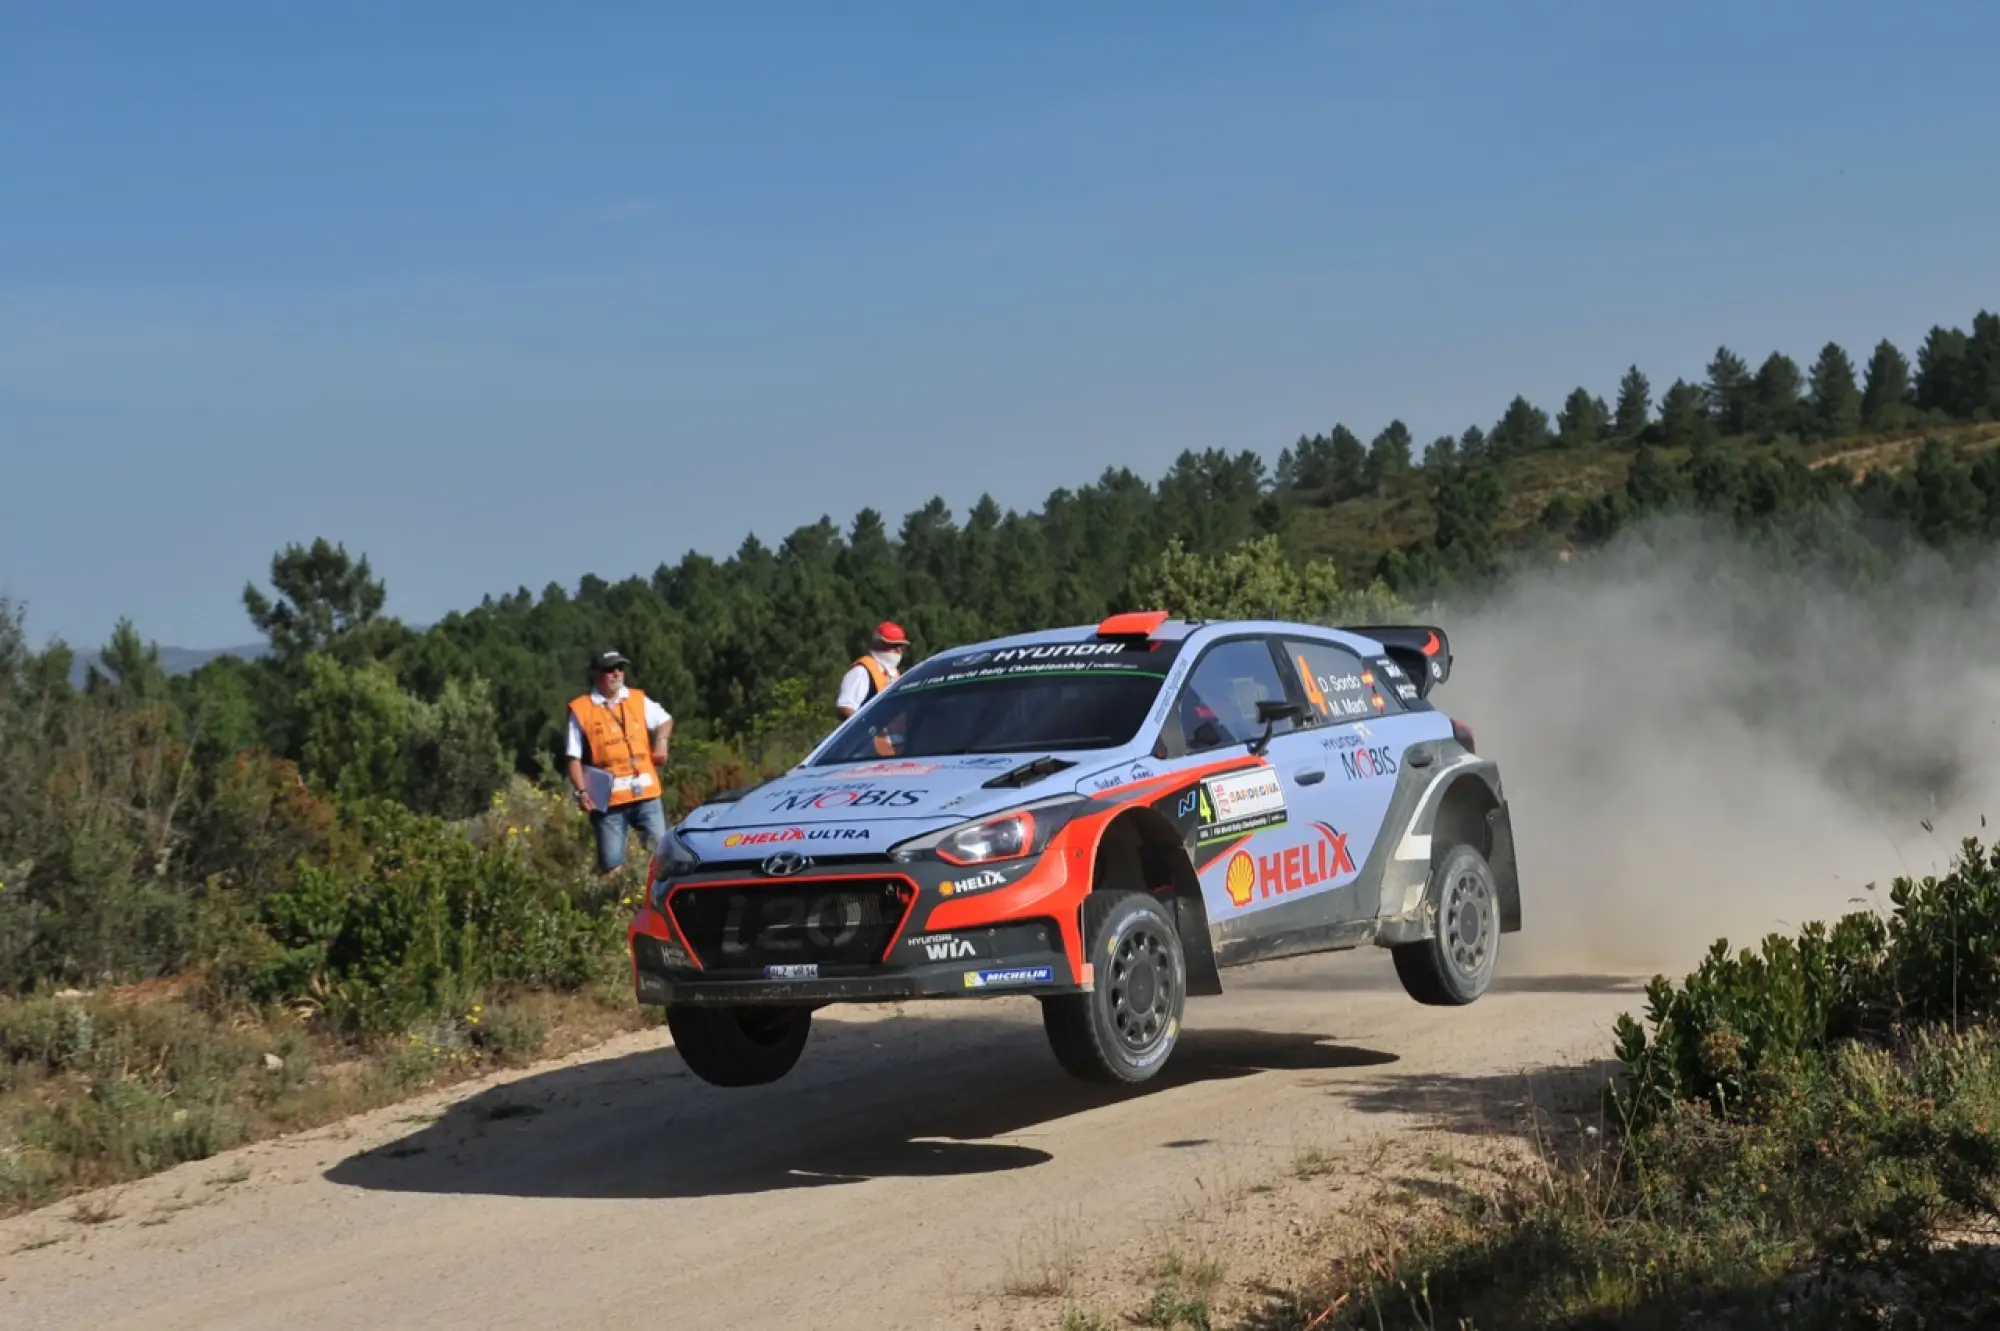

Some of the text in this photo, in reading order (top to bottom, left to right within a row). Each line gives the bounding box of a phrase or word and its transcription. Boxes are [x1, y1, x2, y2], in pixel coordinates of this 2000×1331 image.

[994, 643, 1126, 662] HYUNDAI
[980, 667, 1005, 678] Rally
[1008, 661, 1086, 674] Championship
[1297, 655, 1328, 715] 4
[1317, 672, 1362, 693] D. Sordo
[1328, 699, 1344, 717] M.
[1340, 746, 1397, 781] MOBIS
[770, 789, 929, 812] MOBIS
[1200, 787, 1212, 825] 4
[741, 828, 870, 845] HELIX ULTRA
[1258, 820, 1354, 899] HELIX
[954, 870, 1007, 893] HELIX
[908, 933, 953, 946] HYUNDAI
[925, 938, 977, 961] WIA
[986, 969, 1038, 982] MICHELIN
